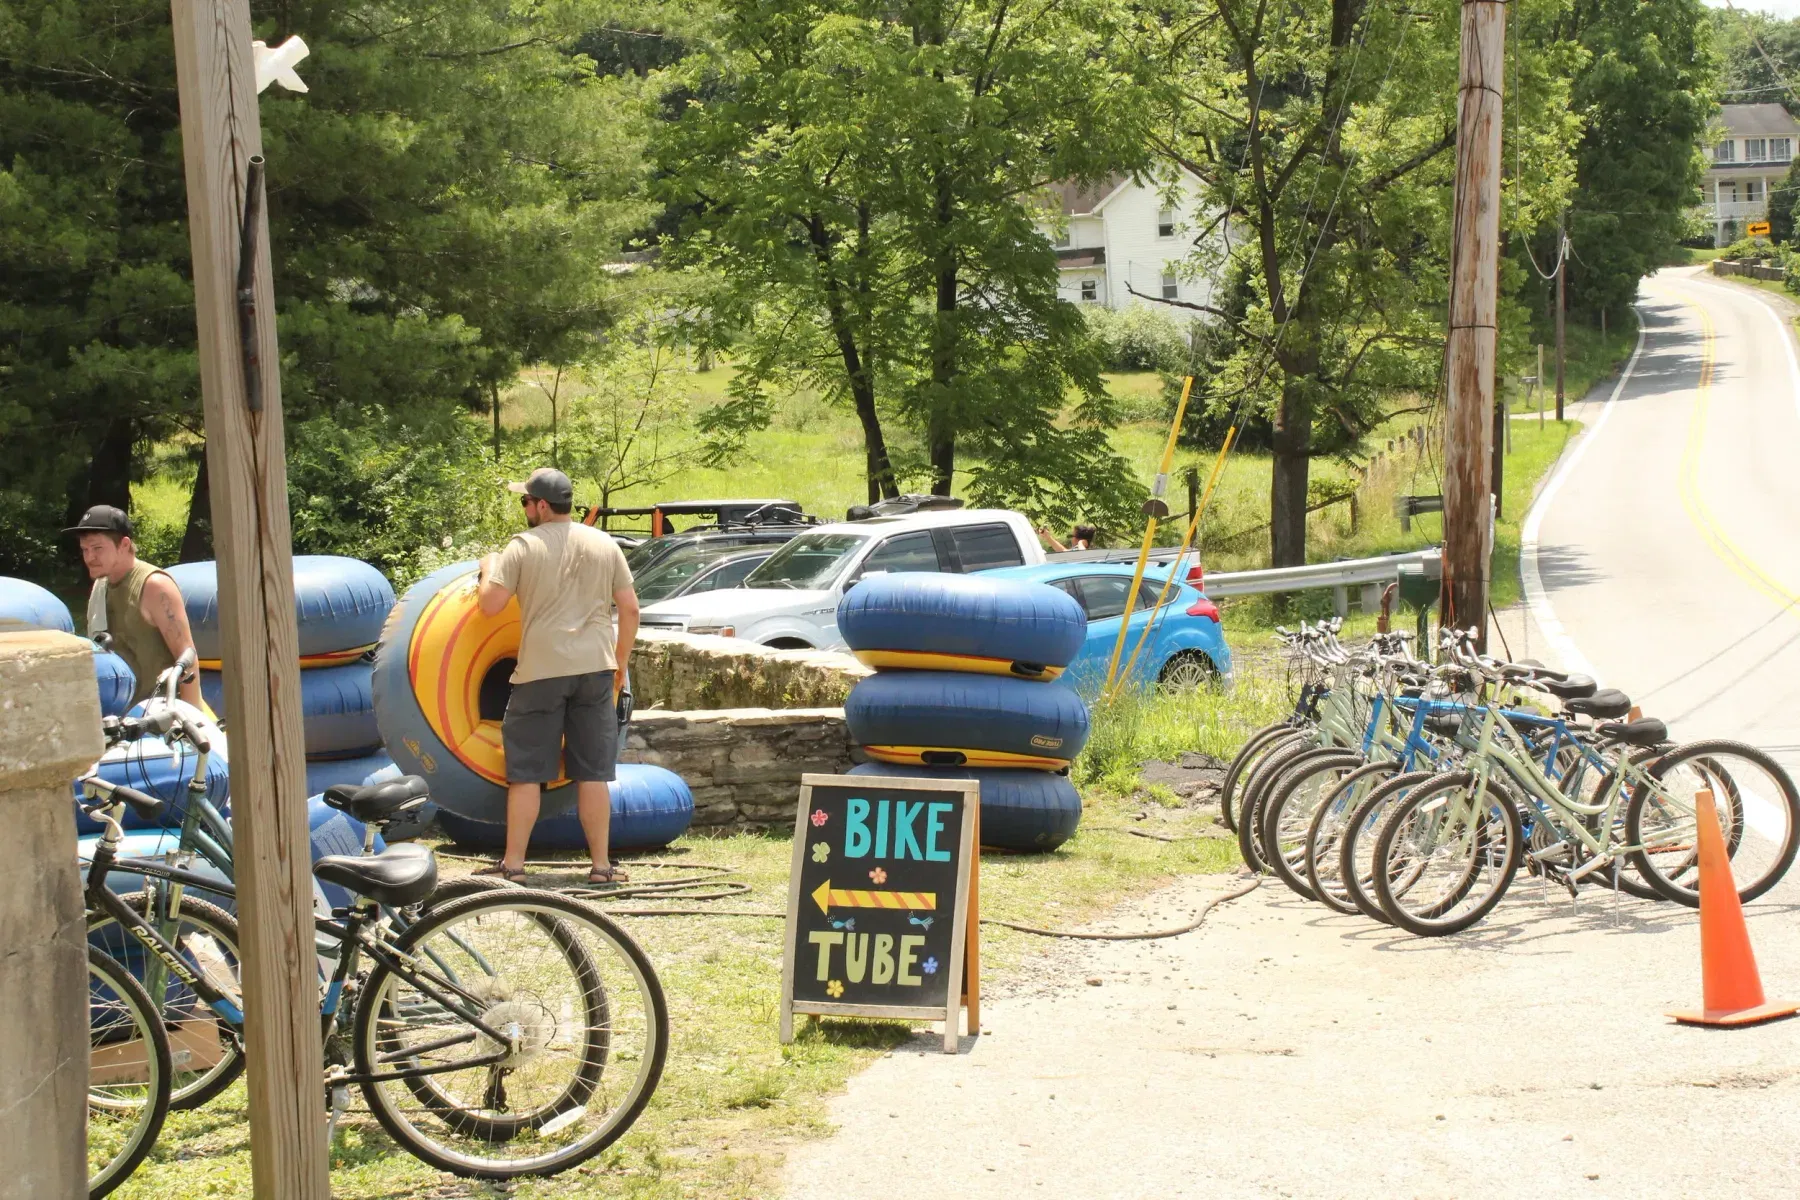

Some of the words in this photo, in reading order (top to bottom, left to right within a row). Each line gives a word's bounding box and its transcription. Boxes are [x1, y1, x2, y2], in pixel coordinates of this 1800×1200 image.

[844, 799, 953, 862] BIKE
[131, 925, 198, 984] RALEIGH
[808, 931, 926, 986] TUBE
